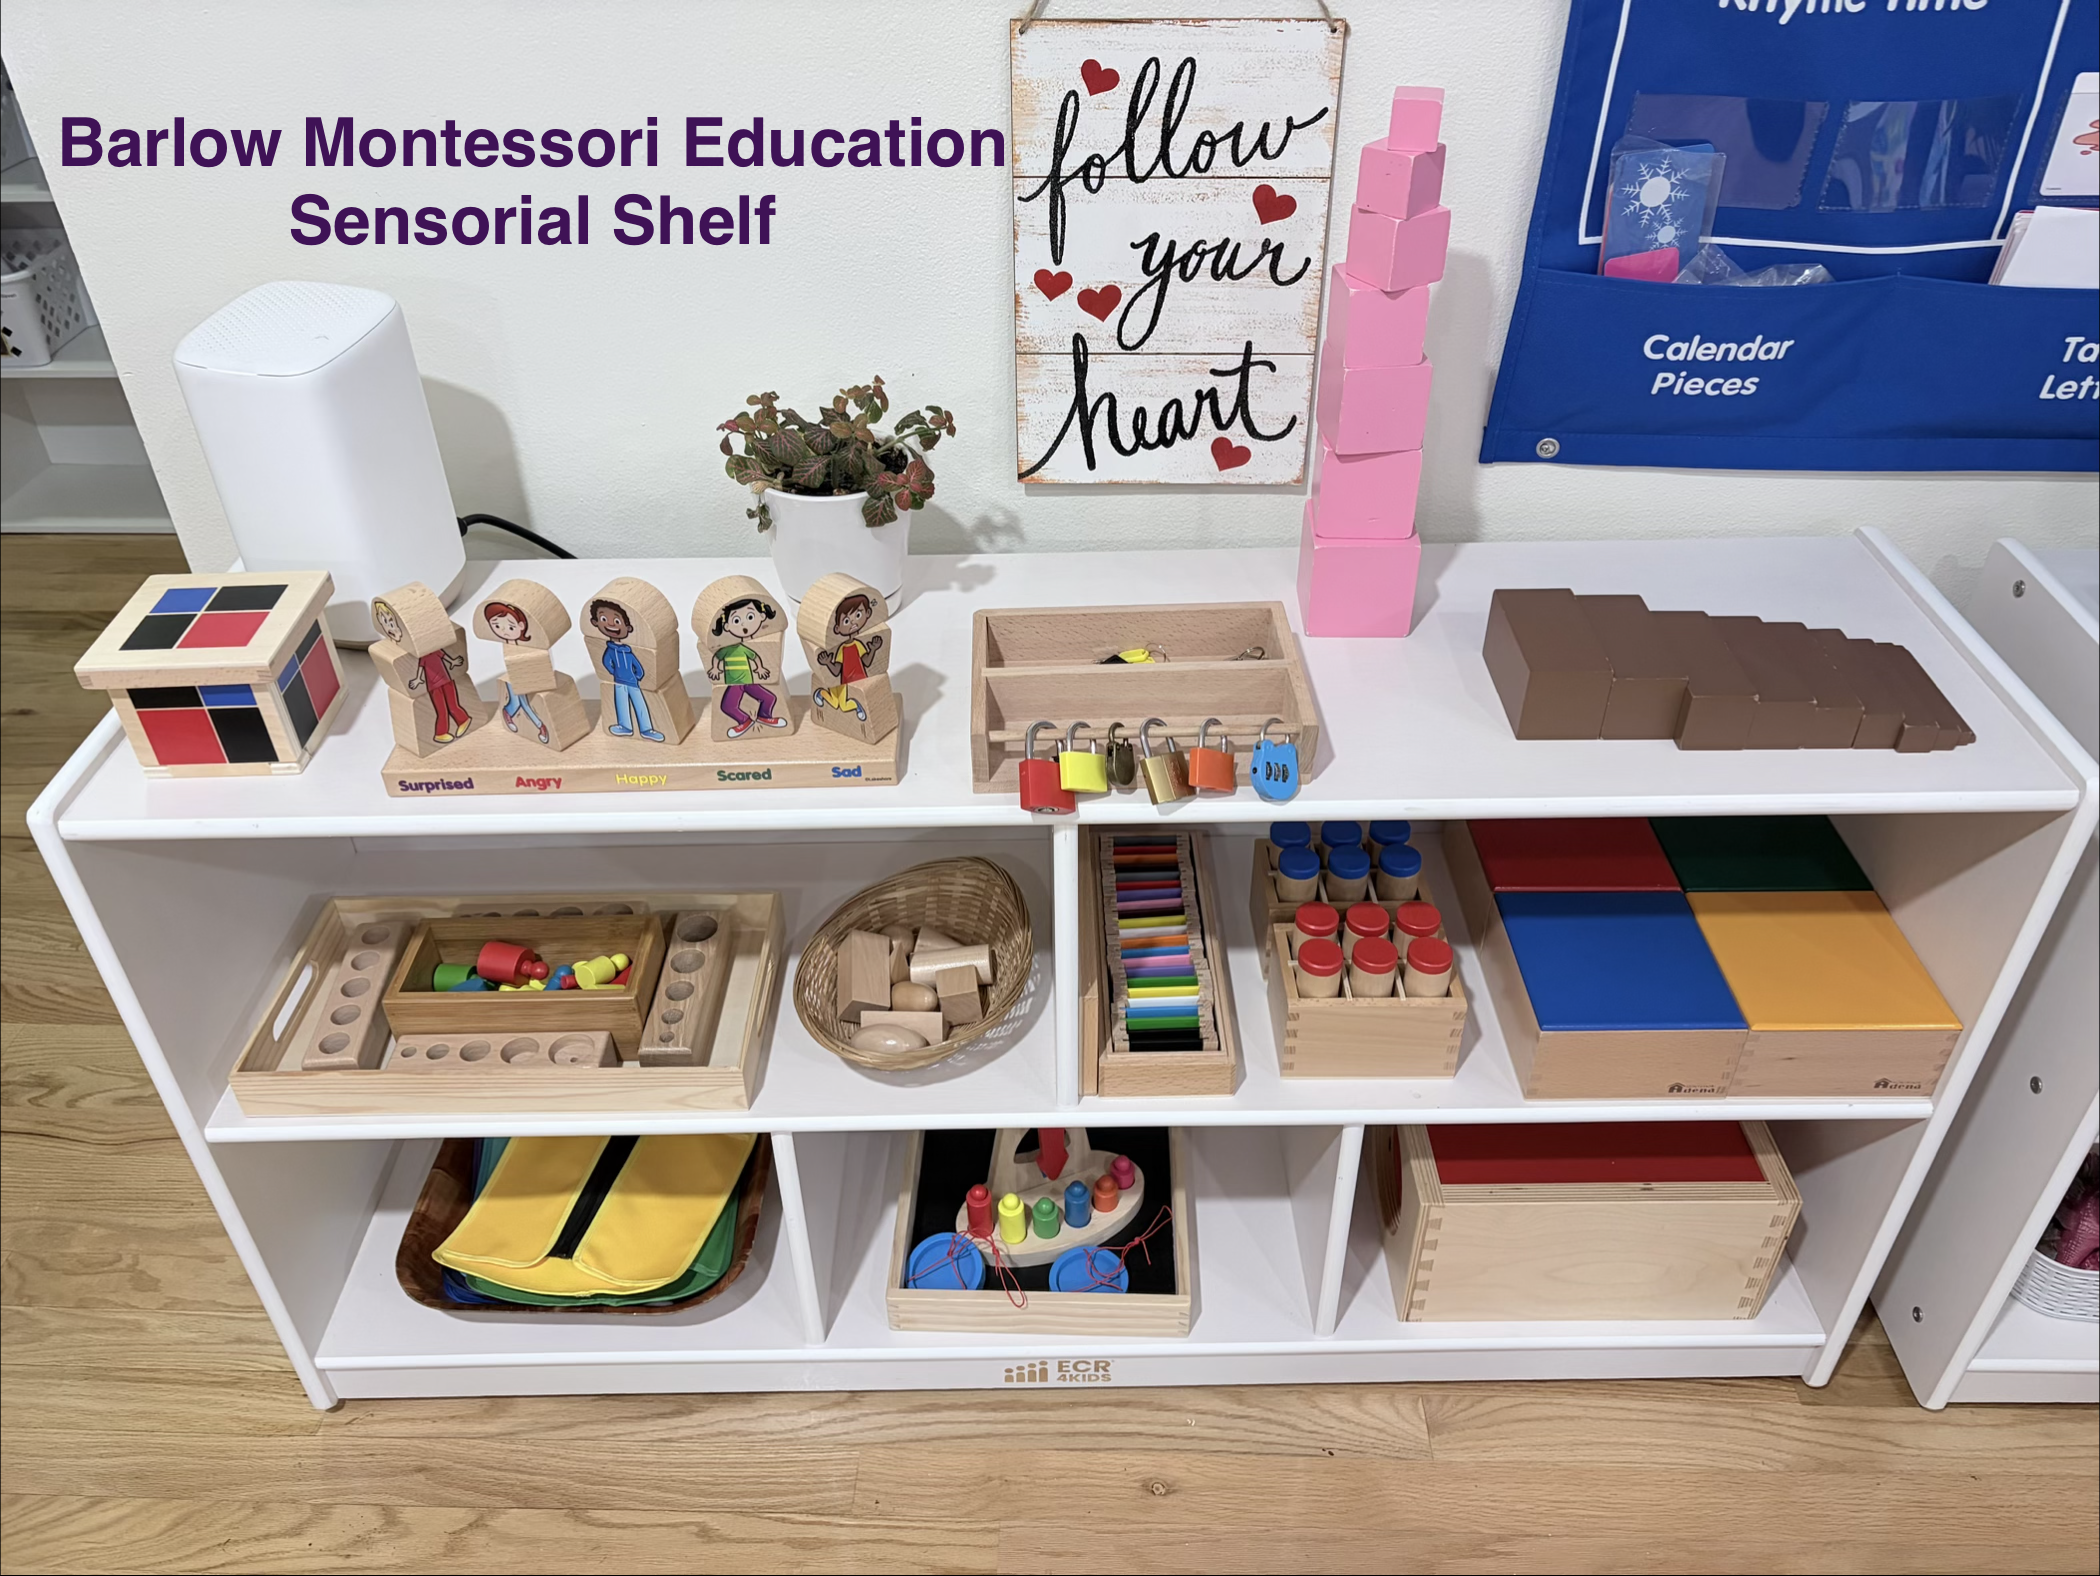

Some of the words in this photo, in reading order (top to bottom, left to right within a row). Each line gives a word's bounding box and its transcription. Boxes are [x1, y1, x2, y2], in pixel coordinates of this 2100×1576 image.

[1018, 56, 1328, 265] follow
[1117, 232, 1311, 351] your
[1643, 334, 1795, 362] Calendar
[1651, 371, 1760, 396] Pieces
[1018, 332, 1296, 479] heart
[717, 768, 772, 782] Scared
[831, 765, 862, 778] Sad
[398, 777, 475, 793] Surprised
[515, 776, 562, 790] Angry
[615, 773, 667, 787] Happy
[1057, 1360, 1111, 1373] ECR
[1056, 1373, 1112, 1382] 4KIDS
